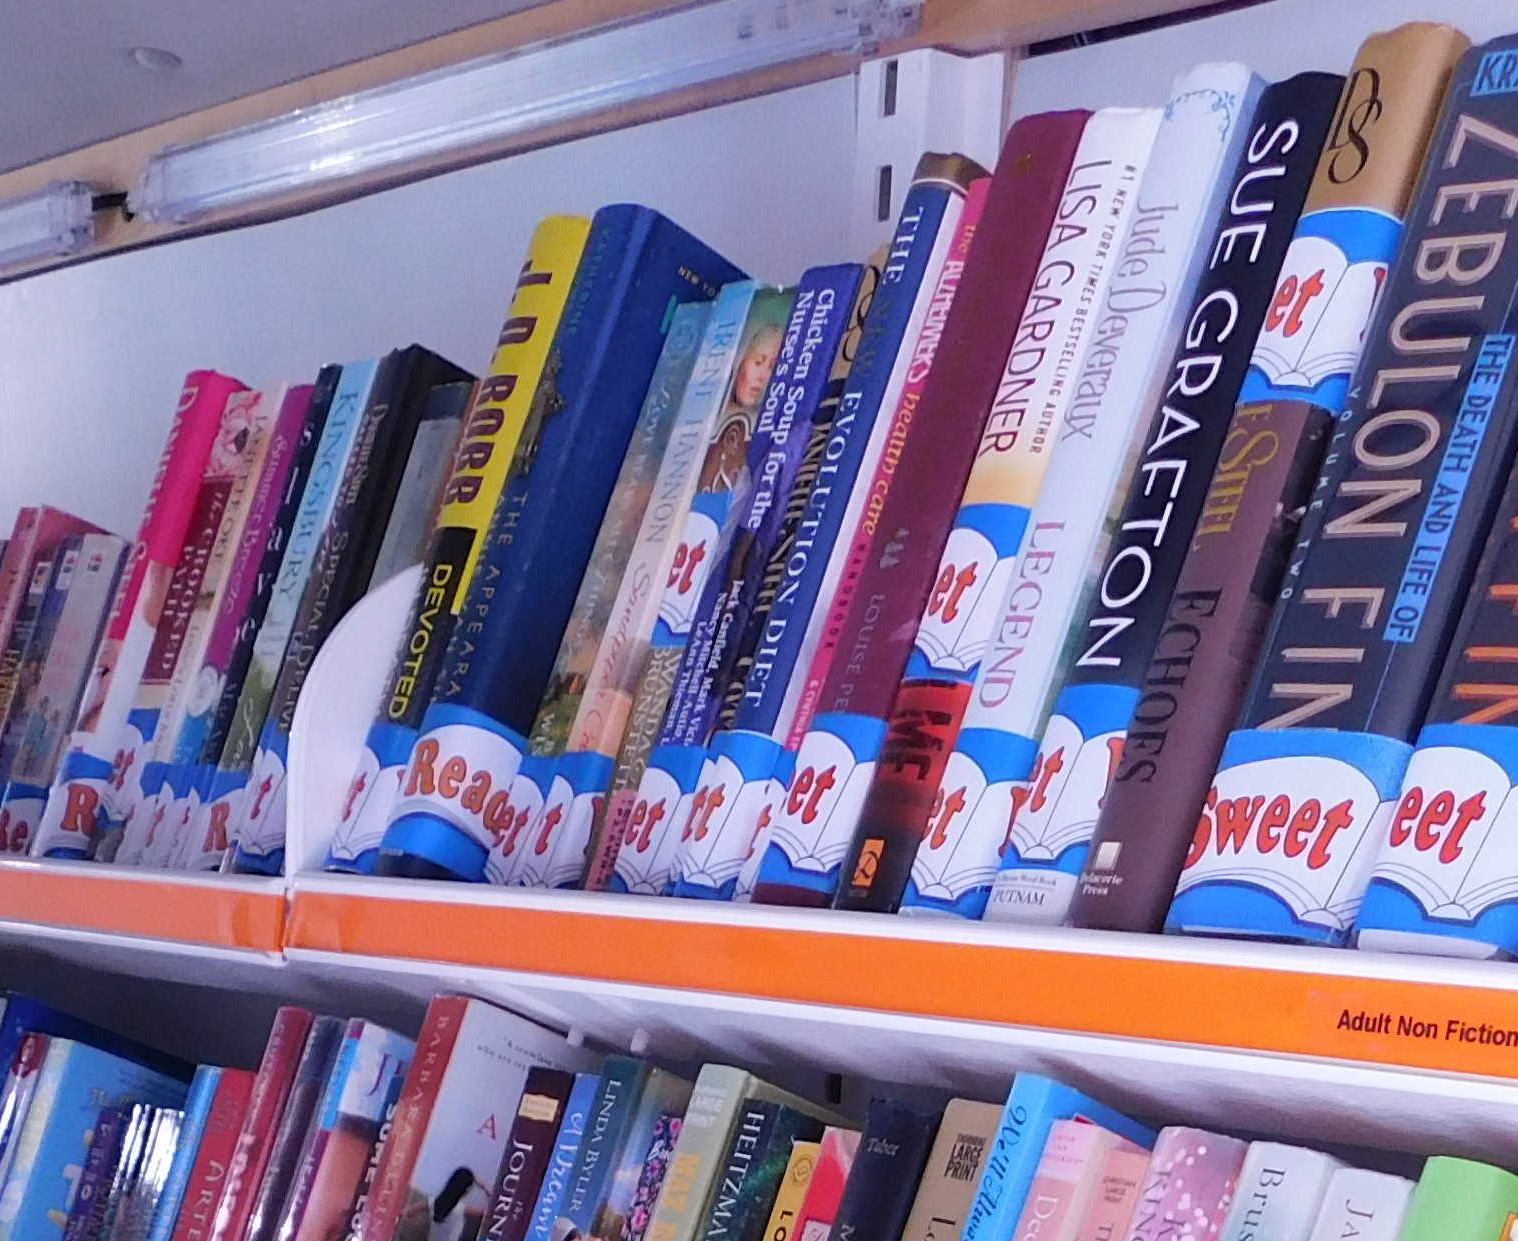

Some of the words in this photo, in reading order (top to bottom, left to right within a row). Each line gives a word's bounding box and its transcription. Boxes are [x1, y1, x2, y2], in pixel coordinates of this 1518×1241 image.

[1048, 160, 1113, 252] LISA
[1210, 119, 1299, 271] SUE
[881, 205, 924, 286] THE
[1116, 195, 1180, 280] Jude
[1079, 265, 1105, 305] TIMES
[694, 320, 737, 401] IRENE
[776, 289, 815, 376] Nurse's
[794, 287, 835, 380] Chicken
[978, 260, 1076, 458] GARDNER
[1060, 280, 1168, 443] Deveraux
[1483, 335, 1512, 383] THE
[758, 382, 785, 434] Soul
[769, 385, 805, 445] Soup
[1028, 402, 1058, 455] AUTHOR
[1434, 393, 1498, 474] DEATH
[645, 417, 703, 544] HANNON
[763, 451, 787, 482] for
[778, 391, 863, 608] EVOLUTION
[1075, 289, 1239, 668] GRAFTON
[747, 485, 773, 530] the
[1420, 483, 1462, 534] AND
[1401, 543, 1439, 601] LIFE
[388, 564, 453, 718] DEVOTED
[978, 520, 1067, 710] LEGEND
[1387, 603, 1421, 640] OF
[745, 618, 787, 709] DIET
[1115, 588, 1223, 785] ECHOES
[992, 888, 1045, 906] PUTNAM
[1336, 1008, 1391, 1038] Adult
[1397, 1014, 1440, 1042] Non
[589, 1078, 623, 1145] LINDA
[943, 1160, 980, 1183] PRINT
